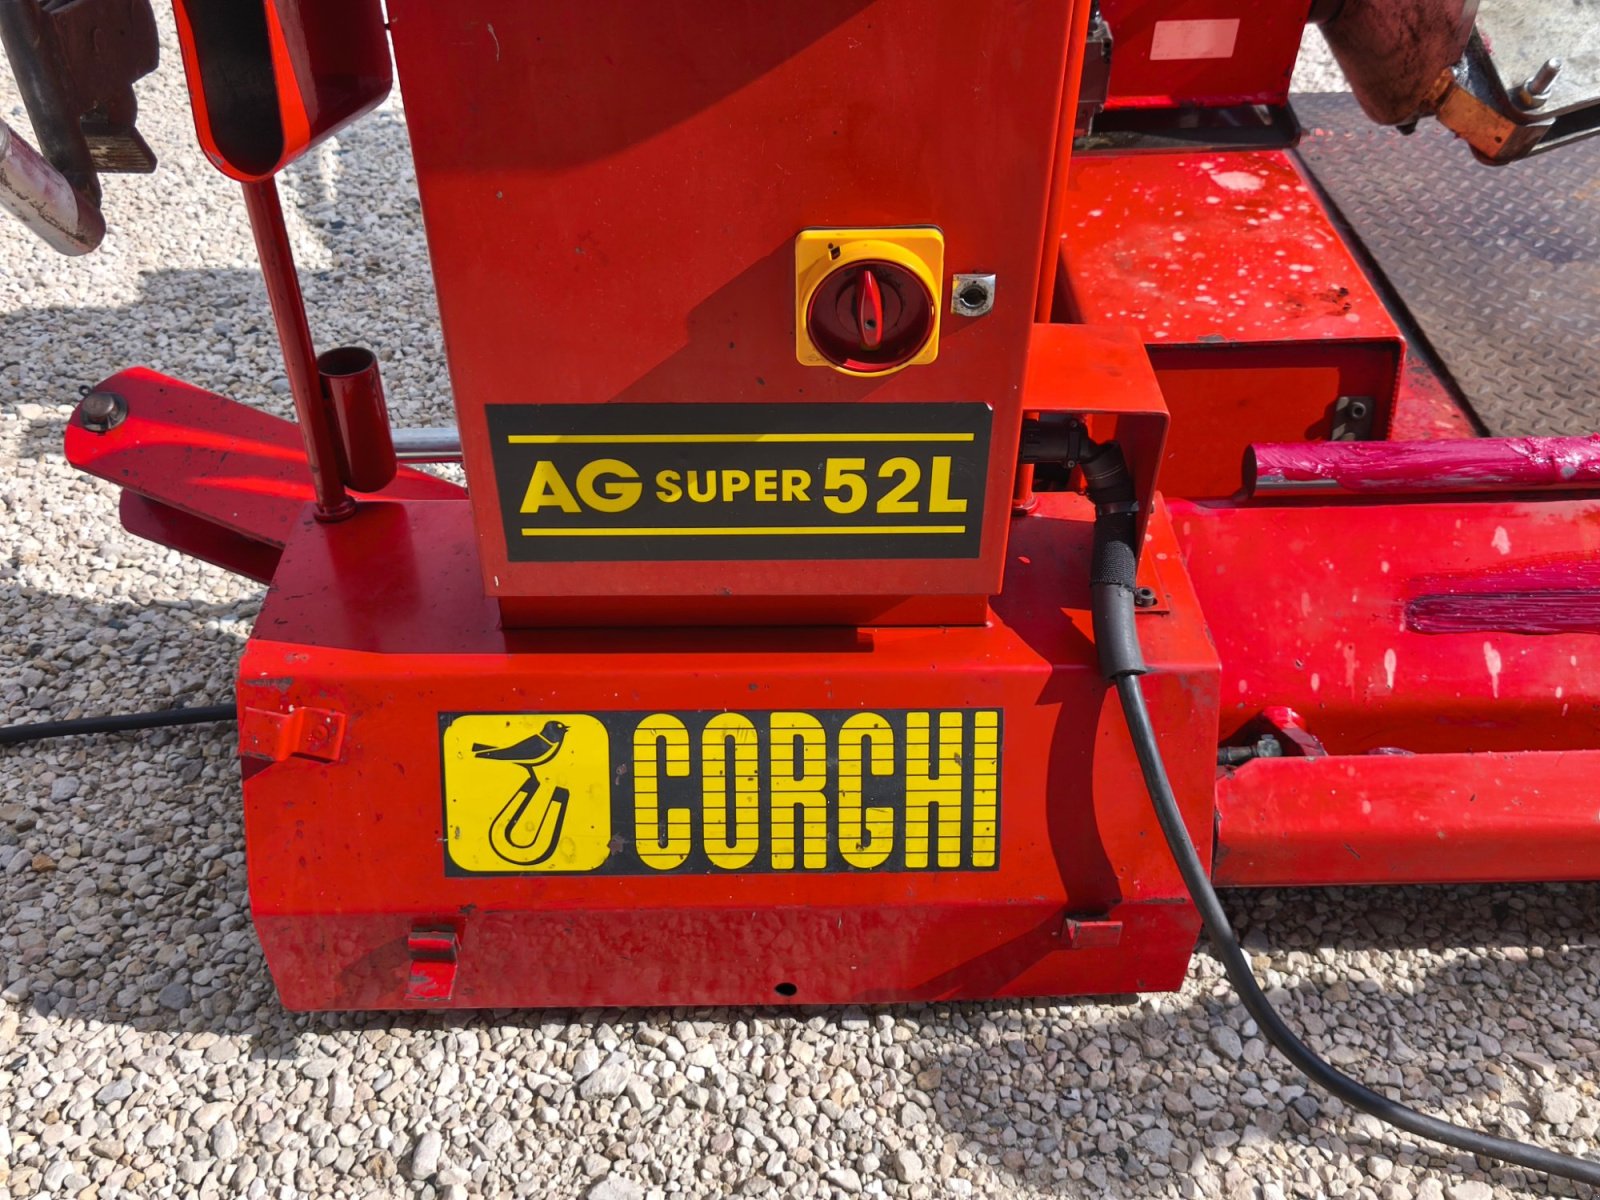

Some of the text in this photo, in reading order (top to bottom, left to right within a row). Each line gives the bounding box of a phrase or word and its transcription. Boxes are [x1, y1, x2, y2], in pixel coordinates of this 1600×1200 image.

[519, 455, 968, 515] AG SUPER 52L
[632, 710, 999, 871] CORGHI
